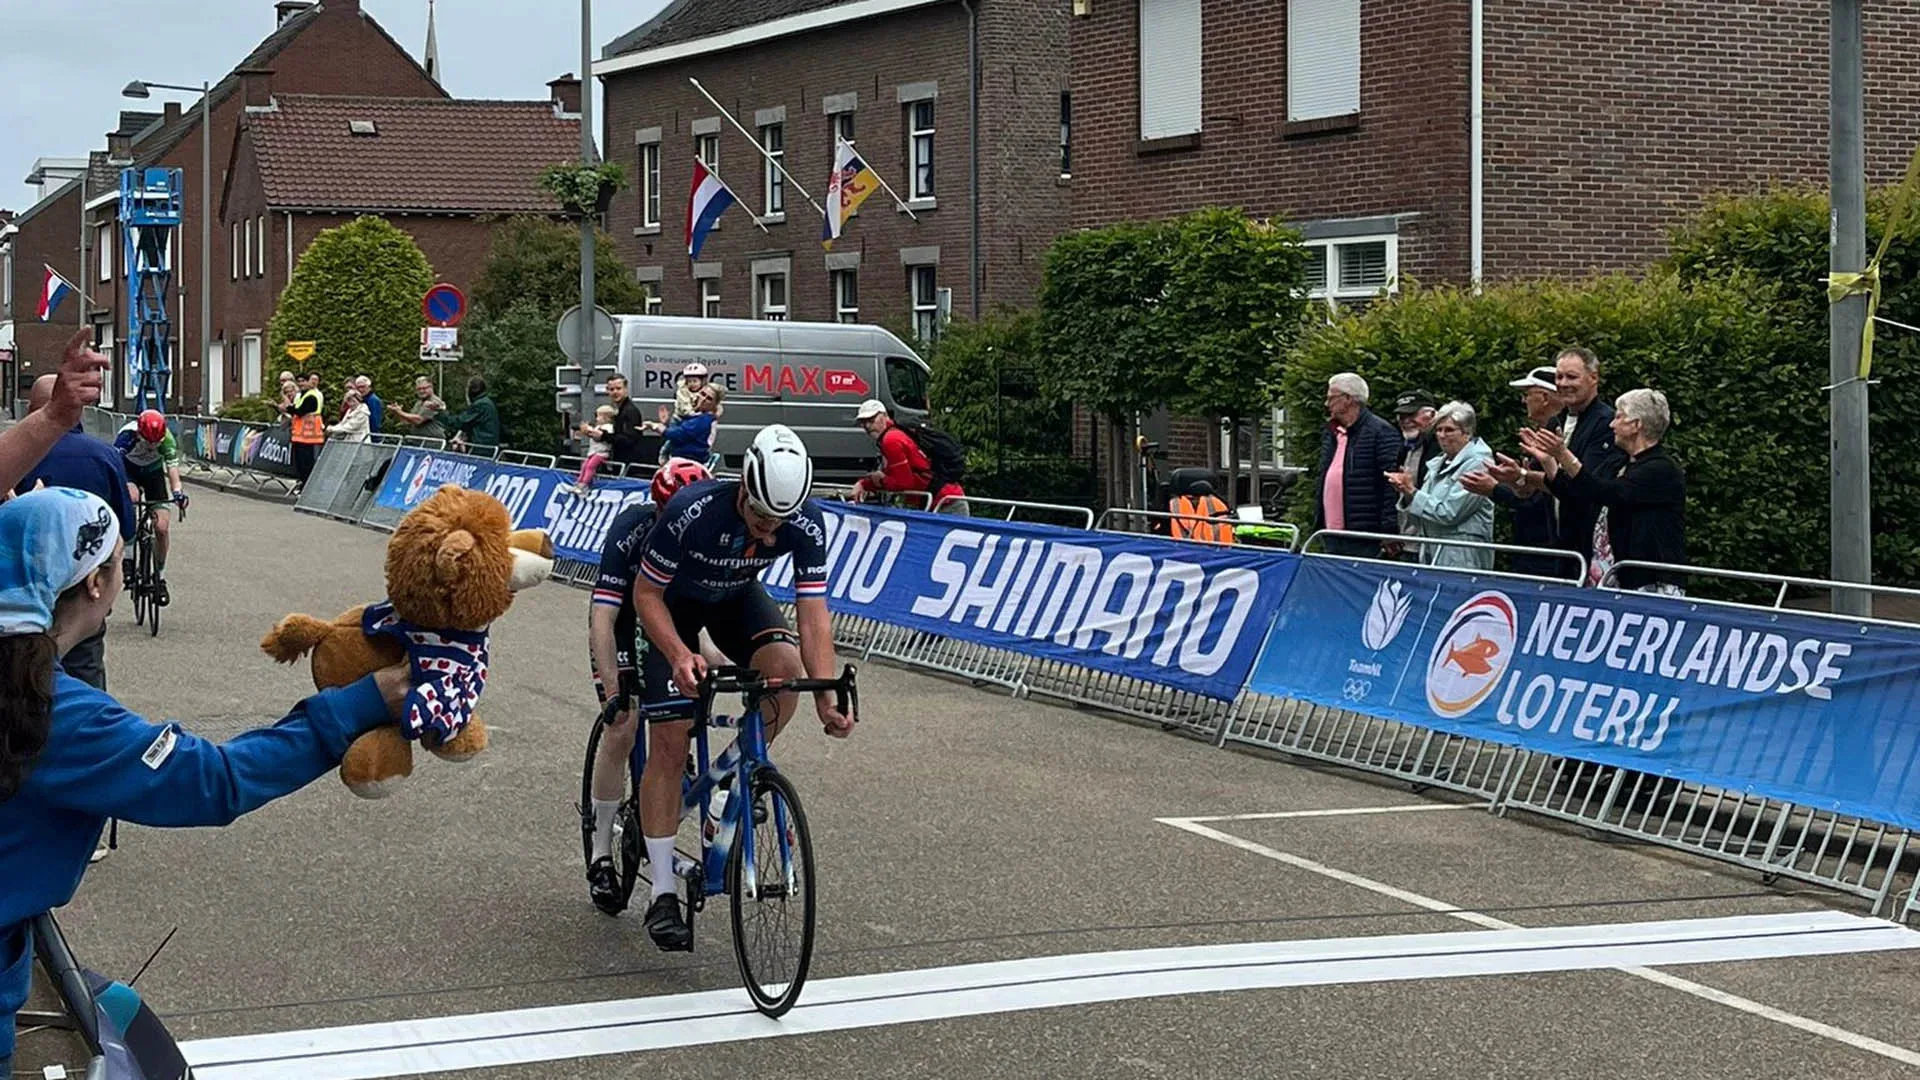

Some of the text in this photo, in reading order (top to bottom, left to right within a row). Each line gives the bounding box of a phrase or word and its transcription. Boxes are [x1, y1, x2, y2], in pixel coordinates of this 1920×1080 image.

[644, 354, 658, 364] De
[696, 356, 728, 367] Toyota
[743, 363, 822, 396] MAX
[830, 375, 842, 386] 17
[912, 529, 1261, 675] SHIMANO
[1521, 602, 1853, 700] NEDERLANDSE
[1348, 659, 1383, 677] TeamNL
[1497, 670, 1680, 751] LOTERIJ
